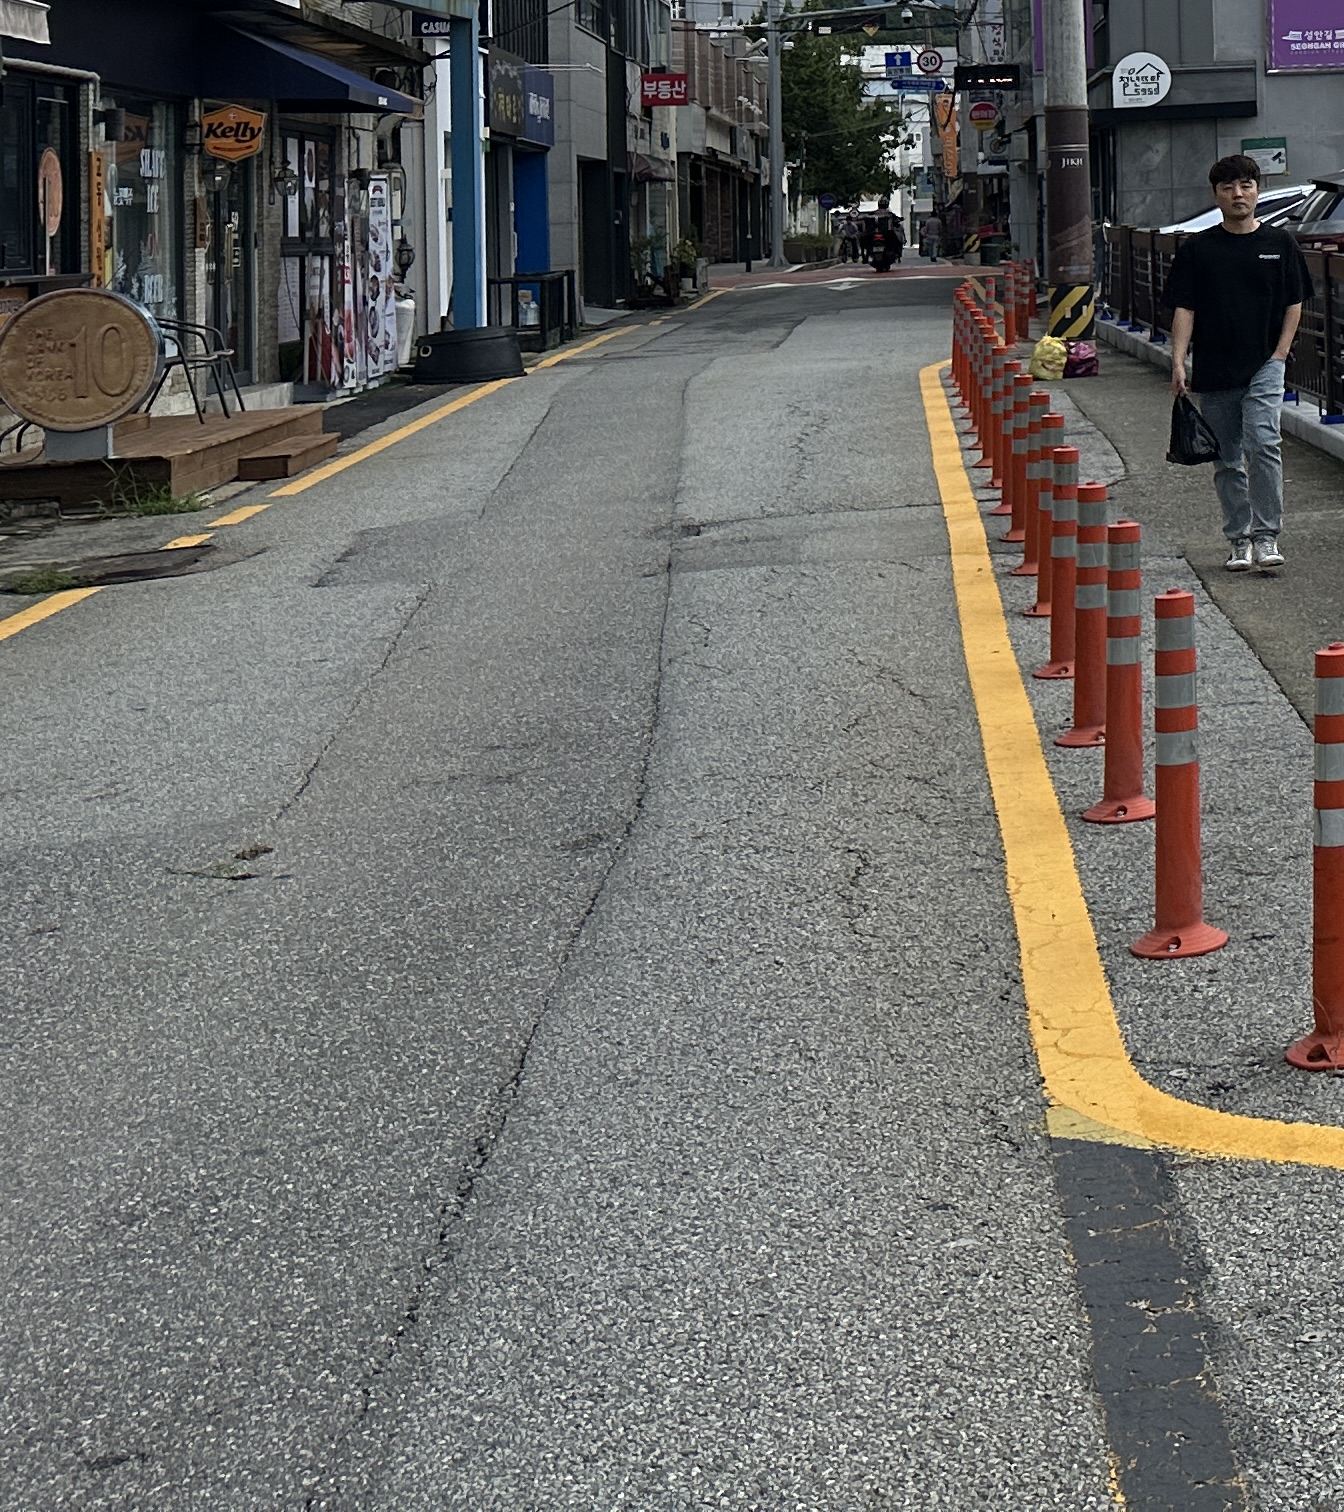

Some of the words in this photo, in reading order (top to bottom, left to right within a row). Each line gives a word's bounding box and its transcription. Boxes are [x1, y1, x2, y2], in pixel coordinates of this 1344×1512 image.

[420, 21, 450, 34] CASU
[1303, 29, 1333, 41] 성안길
[922, 56, 937, 66] 30
[643, 79, 687, 99] 부동산
[205, 121, 263, 143] Kelly
[70, 324, 134, 399] 10
